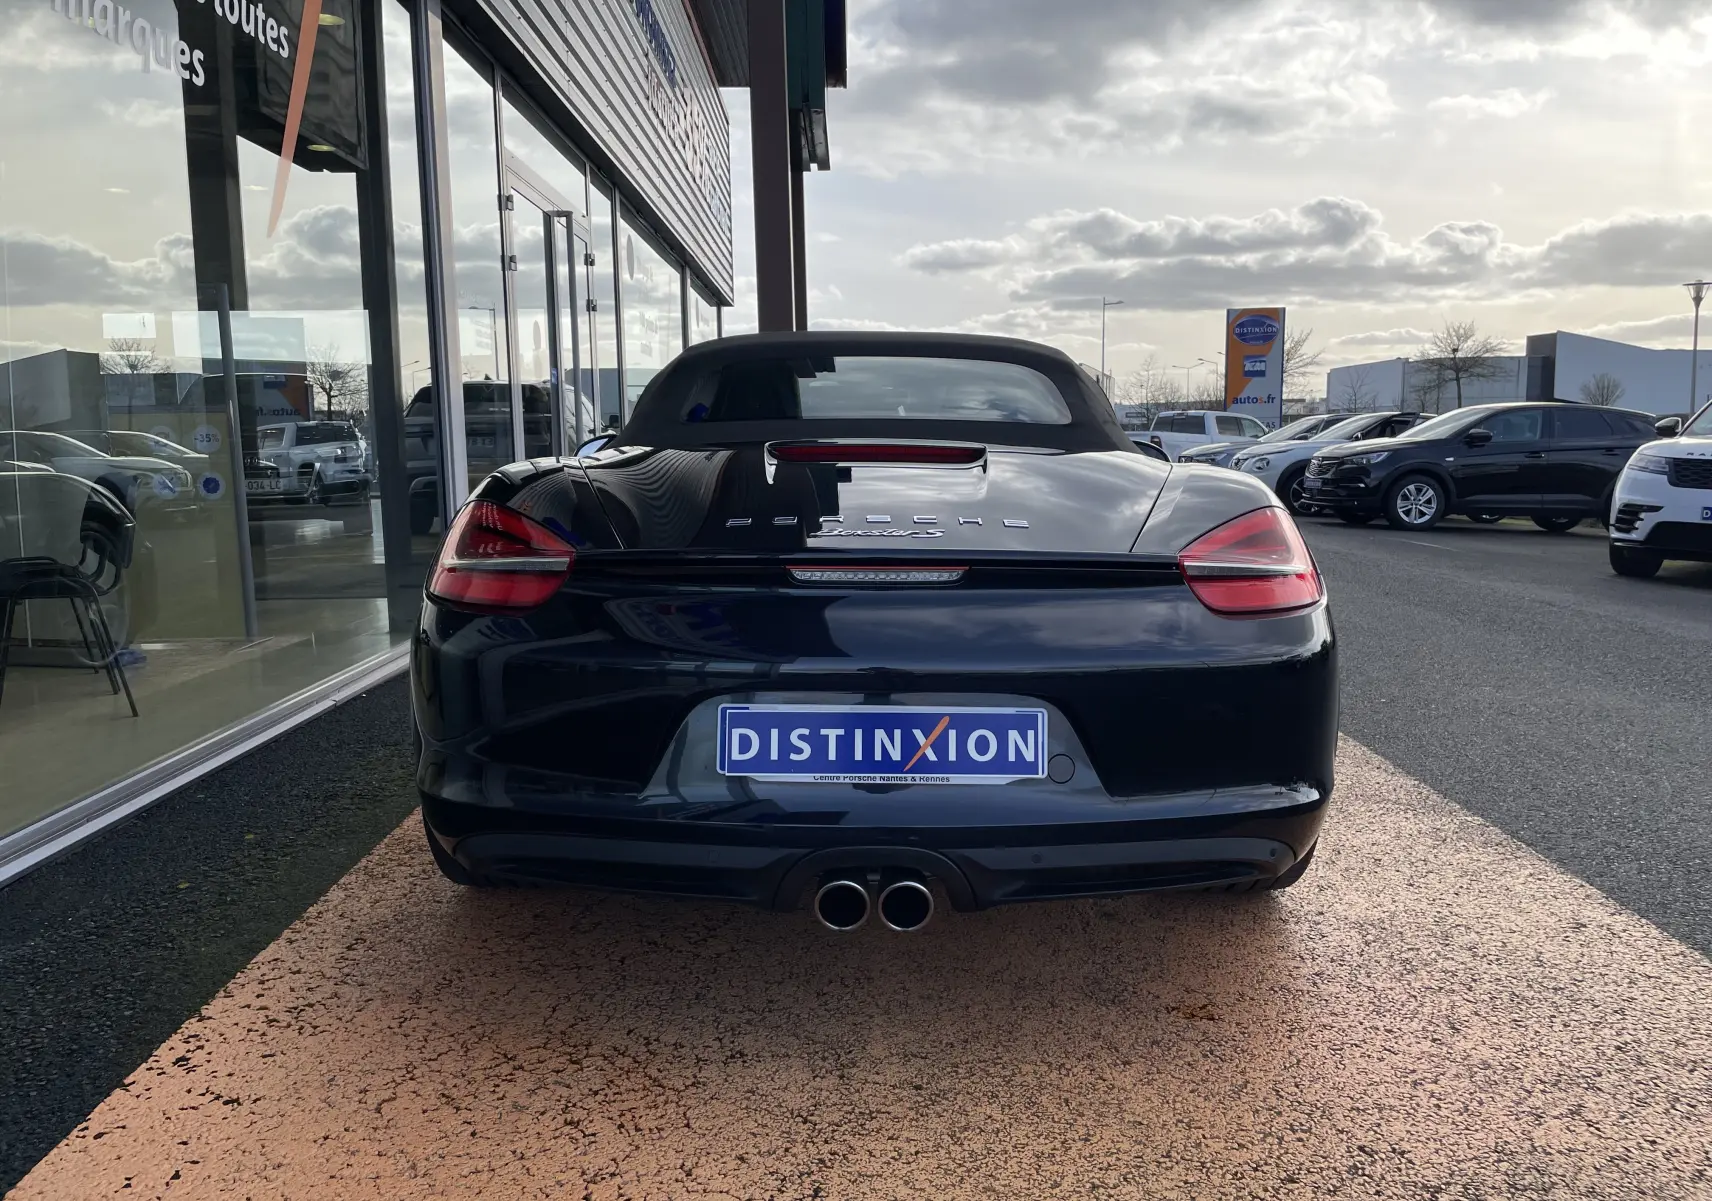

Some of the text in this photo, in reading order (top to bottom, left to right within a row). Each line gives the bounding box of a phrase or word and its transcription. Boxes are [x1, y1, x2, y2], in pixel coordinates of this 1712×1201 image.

[1232, 394, 1276, 404] autos.fr
[194, 433, 219, 443] -35%
[726, 514, 1029, 528] PORSCHE
[809, 527, 945, 538] Boxster S
[731, 722, 1036, 768] DISTINXION
